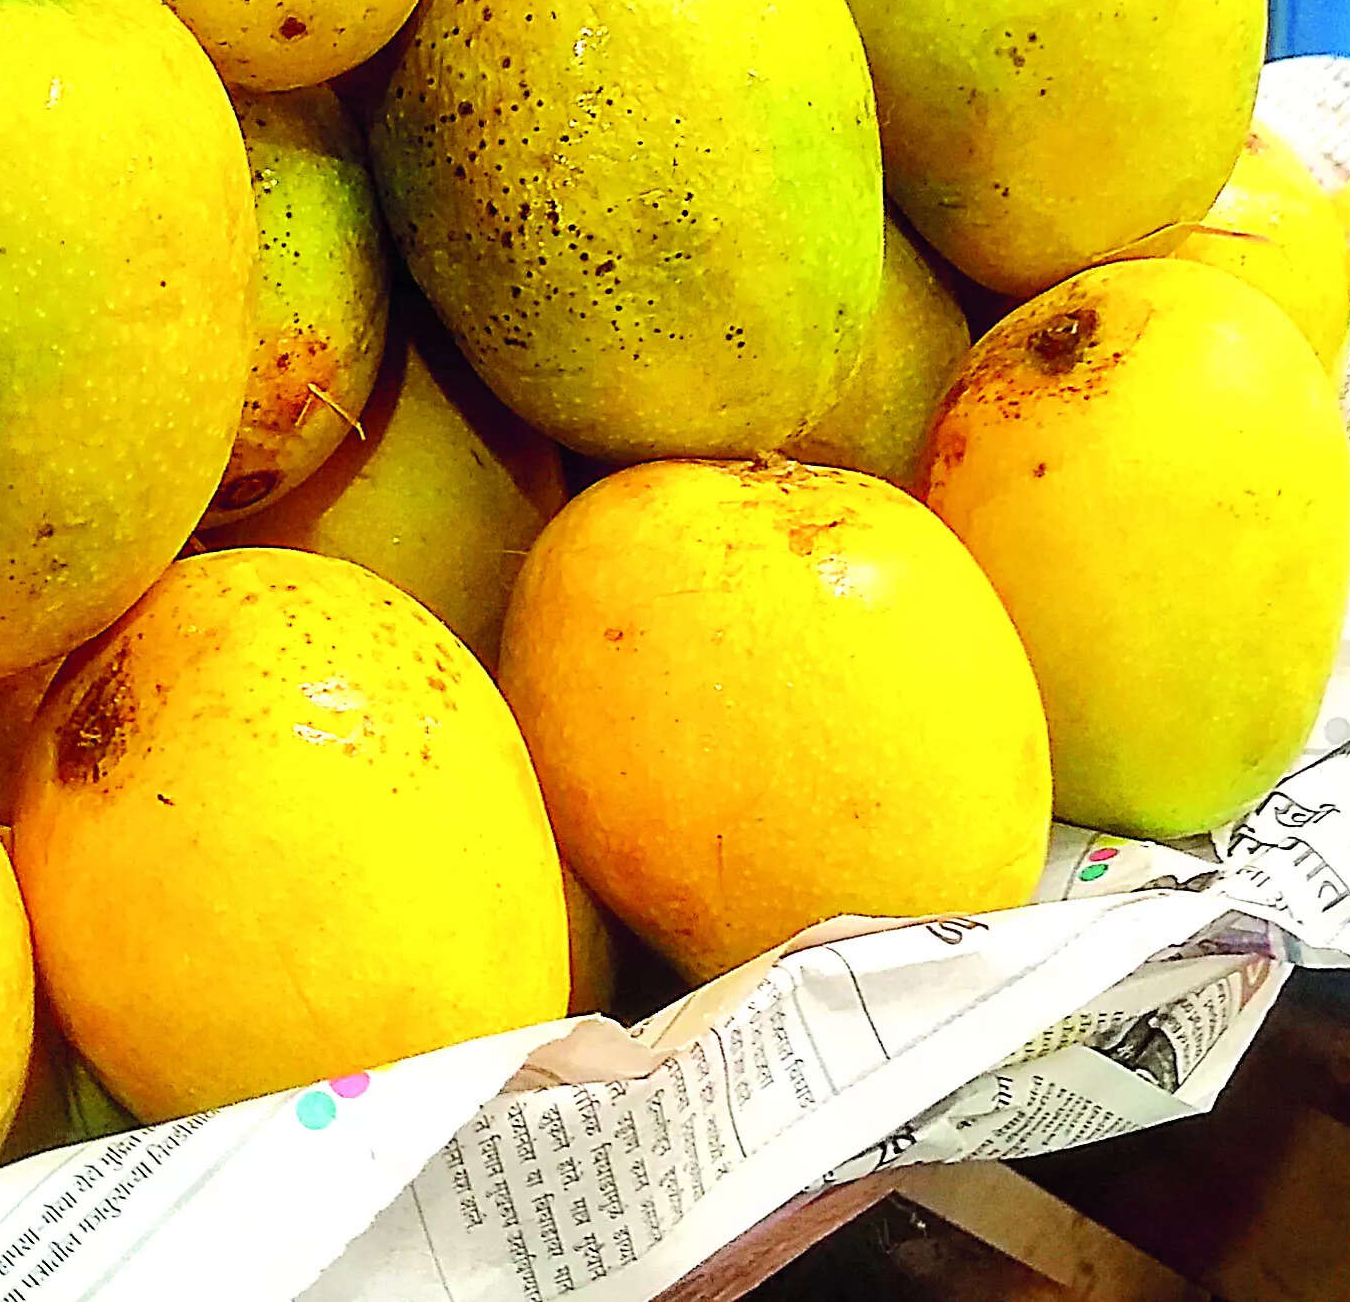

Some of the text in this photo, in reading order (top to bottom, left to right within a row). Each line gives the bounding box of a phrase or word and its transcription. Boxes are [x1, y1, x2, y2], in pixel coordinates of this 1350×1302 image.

[471, 1114, 495, 1133] ते
[539, 1103, 575, 1152] झुकले
[478, 1134, 504, 1178] विमान
[75, 1165, 104, 1192] येथे
[453, 1169, 473, 1194] यश
[526, 1168, 544, 1187] या
[557, 1157, 584, 1191] होते.
[630, 1158, 650, 1192] करत
[21, 1232, 82, 1288] पत्रातील
[78, 1162, 154, 1233] मजकुराच्या
[460, 1195, 487, 1234] आले.
[531, 1193, 565, 1260] बिघाडावर
[570, 1197, 591, 1226] मात्र
[554, 1265, 578, 1295] मात
